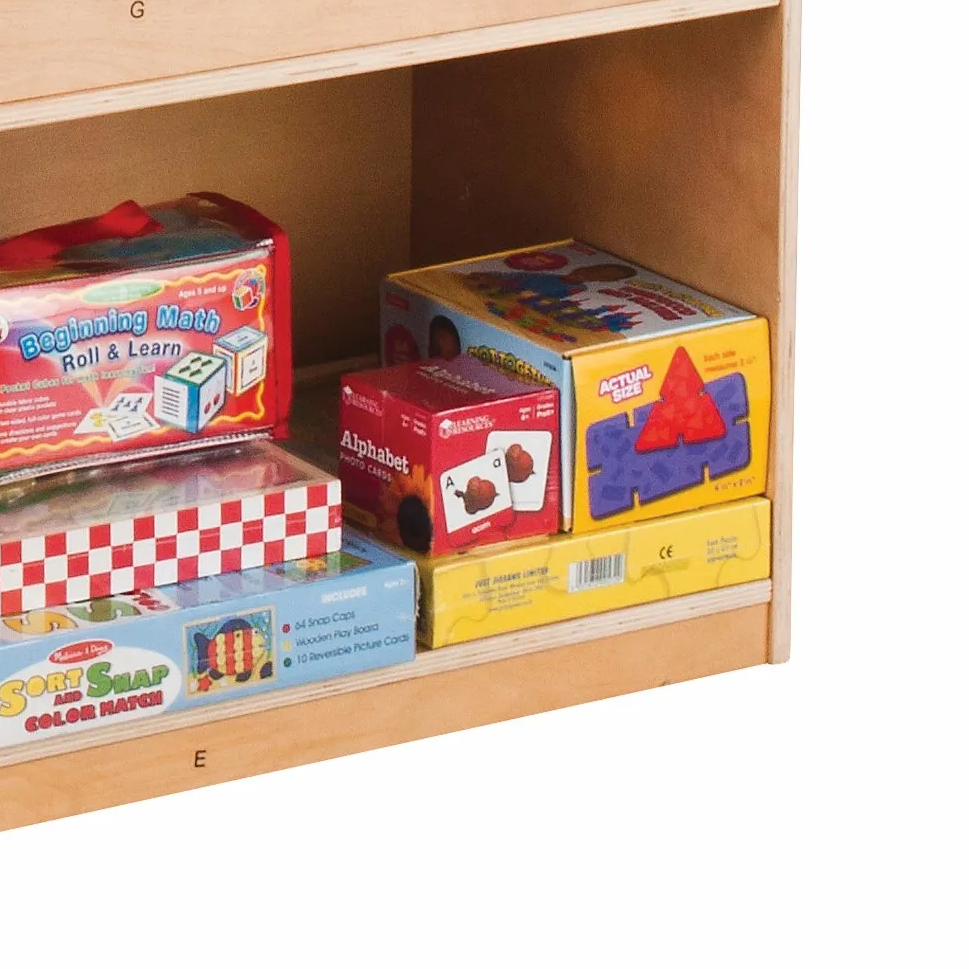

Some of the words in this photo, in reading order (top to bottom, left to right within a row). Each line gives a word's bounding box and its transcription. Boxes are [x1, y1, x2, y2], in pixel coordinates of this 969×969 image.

[130, 0, 145, 19] G
[19, 307, 148, 362] Beginning
[154, 303, 221, 335] Math
[62, 346, 98, 372] Roll
[106, 343, 119, 361] &
[129, 339, 181, 357] Learn
[600, 365, 652, 395] ACTUAL
[612, 383, 642, 403] SIZE
[452, 416, 489, 428] LEARNING
[340, 429, 410, 475] Alphabet
[339, 451, 366, 470] PHOTO
[367, 464, 393, 482] CARDS
[446, 475, 455, 489] A
[294, 619, 306, 631] 64
[308, 615, 331, 628] Snap
[332, 610, 355, 623] Caps
[295, 632, 332, 647] Wooden
[353, 623, 379, 636] Board
[297, 652, 307, 664] 10
[309, 645, 352, 661] Reversible
[353, 639, 382, 653] Picture
[383, 633, 410, 646] Cards
[86, 661, 169, 698] SNAP
[24, 704, 96, 733] COLOR
[100, 690, 163, 717] MATCH
[54, 690, 82, 706] AND
[194, 749, 206, 768] E
